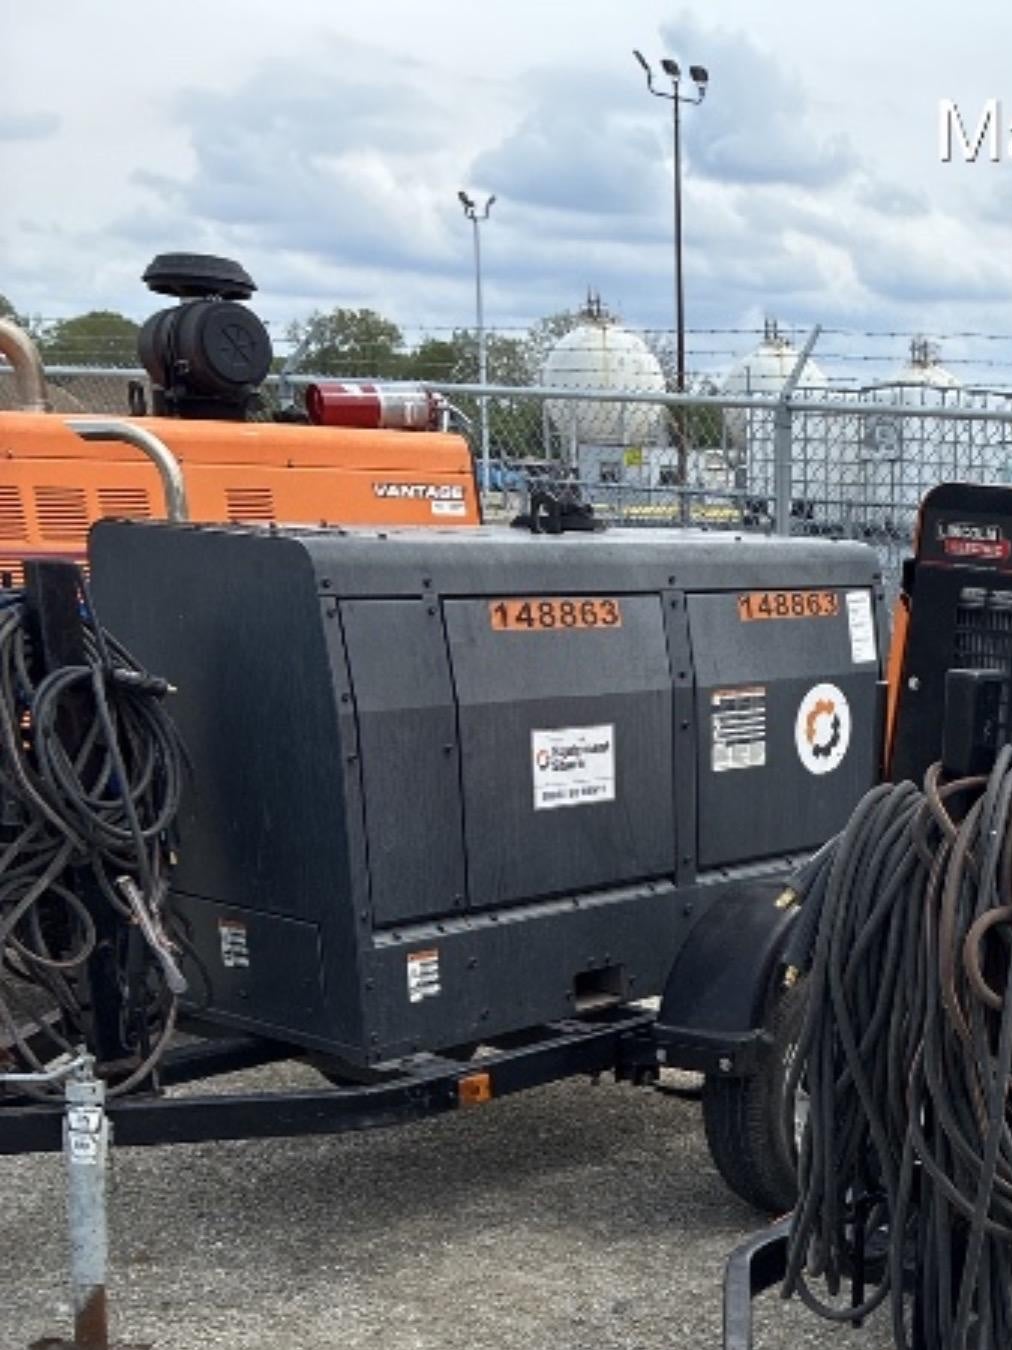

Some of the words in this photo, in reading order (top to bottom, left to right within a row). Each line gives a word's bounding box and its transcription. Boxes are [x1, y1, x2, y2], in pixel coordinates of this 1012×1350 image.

[372, 483, 465, 500] VANTAGE
[493, 601, 620, 627] 148863
[739, 593, 838, 619] 148863
